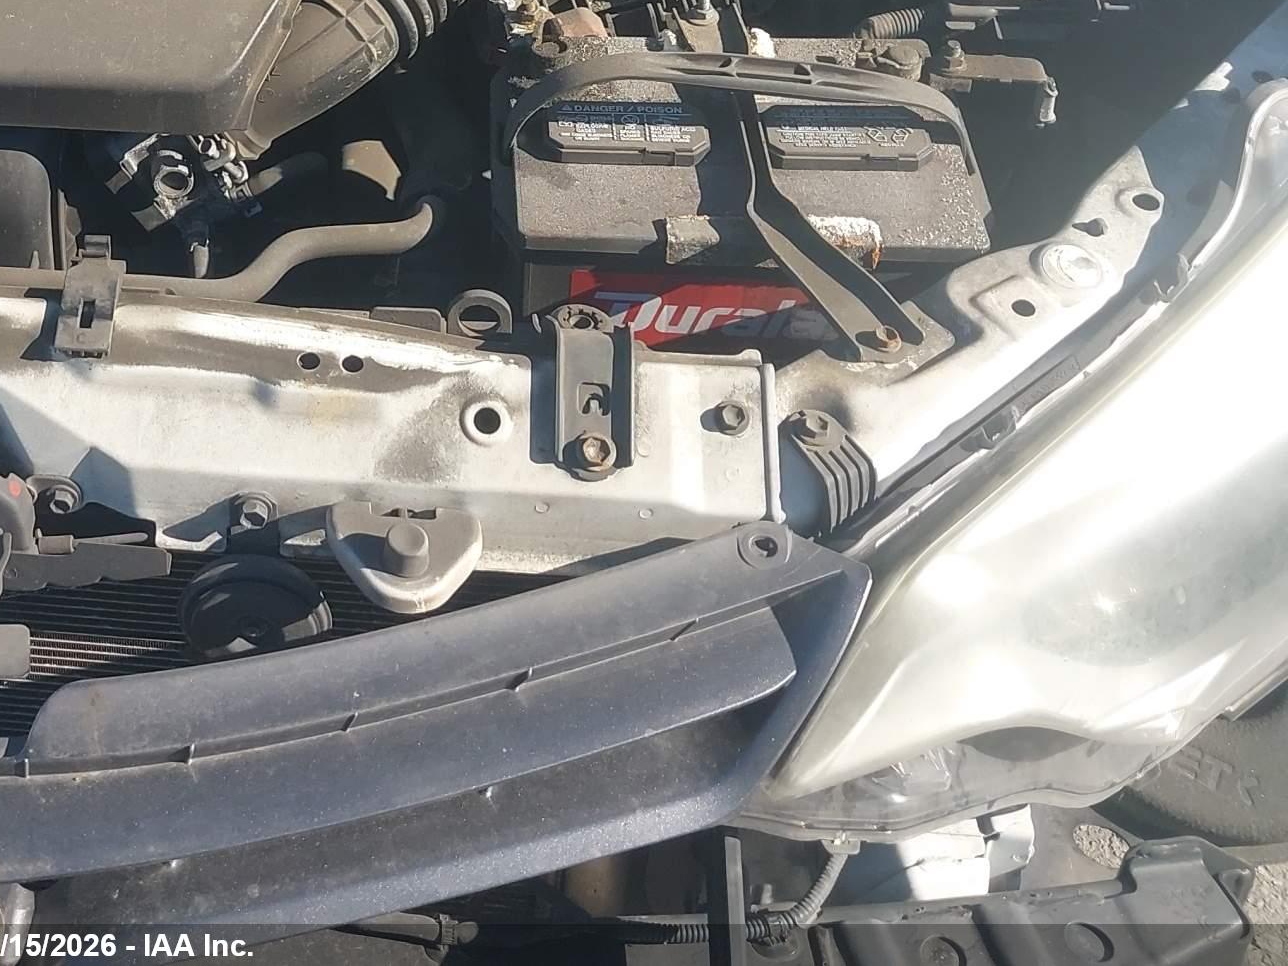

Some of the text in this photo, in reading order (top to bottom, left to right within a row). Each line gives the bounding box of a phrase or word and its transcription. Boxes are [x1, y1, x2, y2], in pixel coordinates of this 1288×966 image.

[574, 104, 624, 113] DANGER
[637, 106, 683, 114] POISON
[594, 290, 839, 340] Durala
